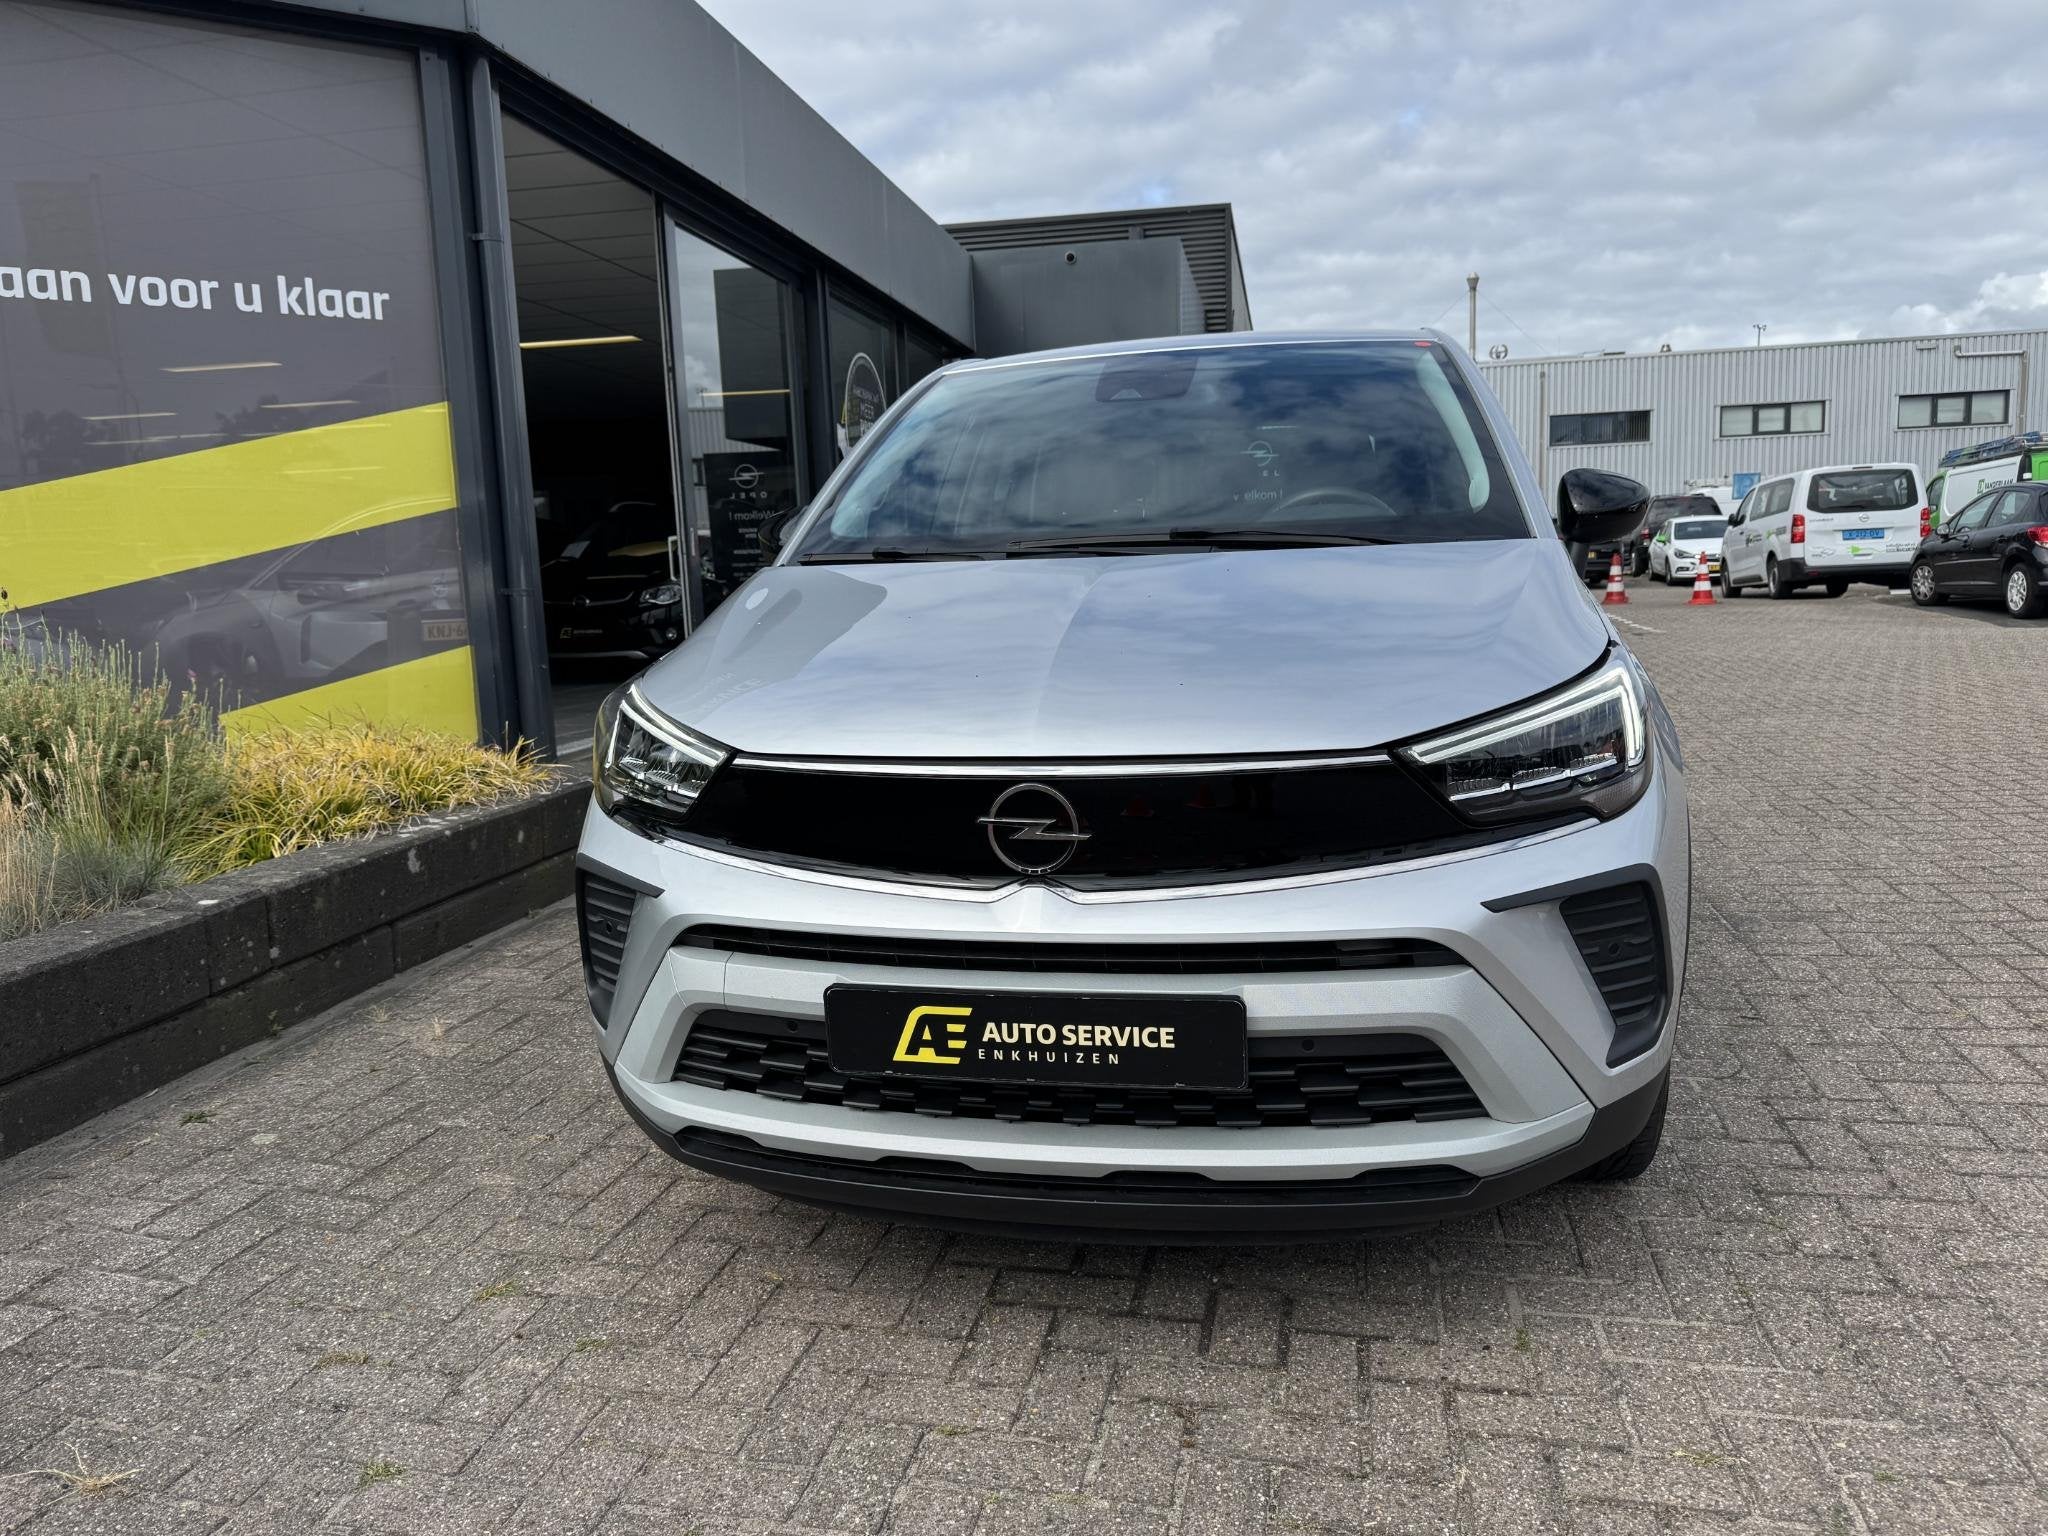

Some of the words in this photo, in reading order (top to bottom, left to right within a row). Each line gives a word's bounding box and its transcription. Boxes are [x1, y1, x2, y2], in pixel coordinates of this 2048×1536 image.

[107, 273, 219, 310] voor
[234, 282, 263, 313] u
[277, 275, 391, 321] klaar
[982, 1021, 1057, 1045] AUTO
[1061, 1024, 1176, 1050] SERVICE
[978, 1049, 1121, 1066] ENKHUIZEN
